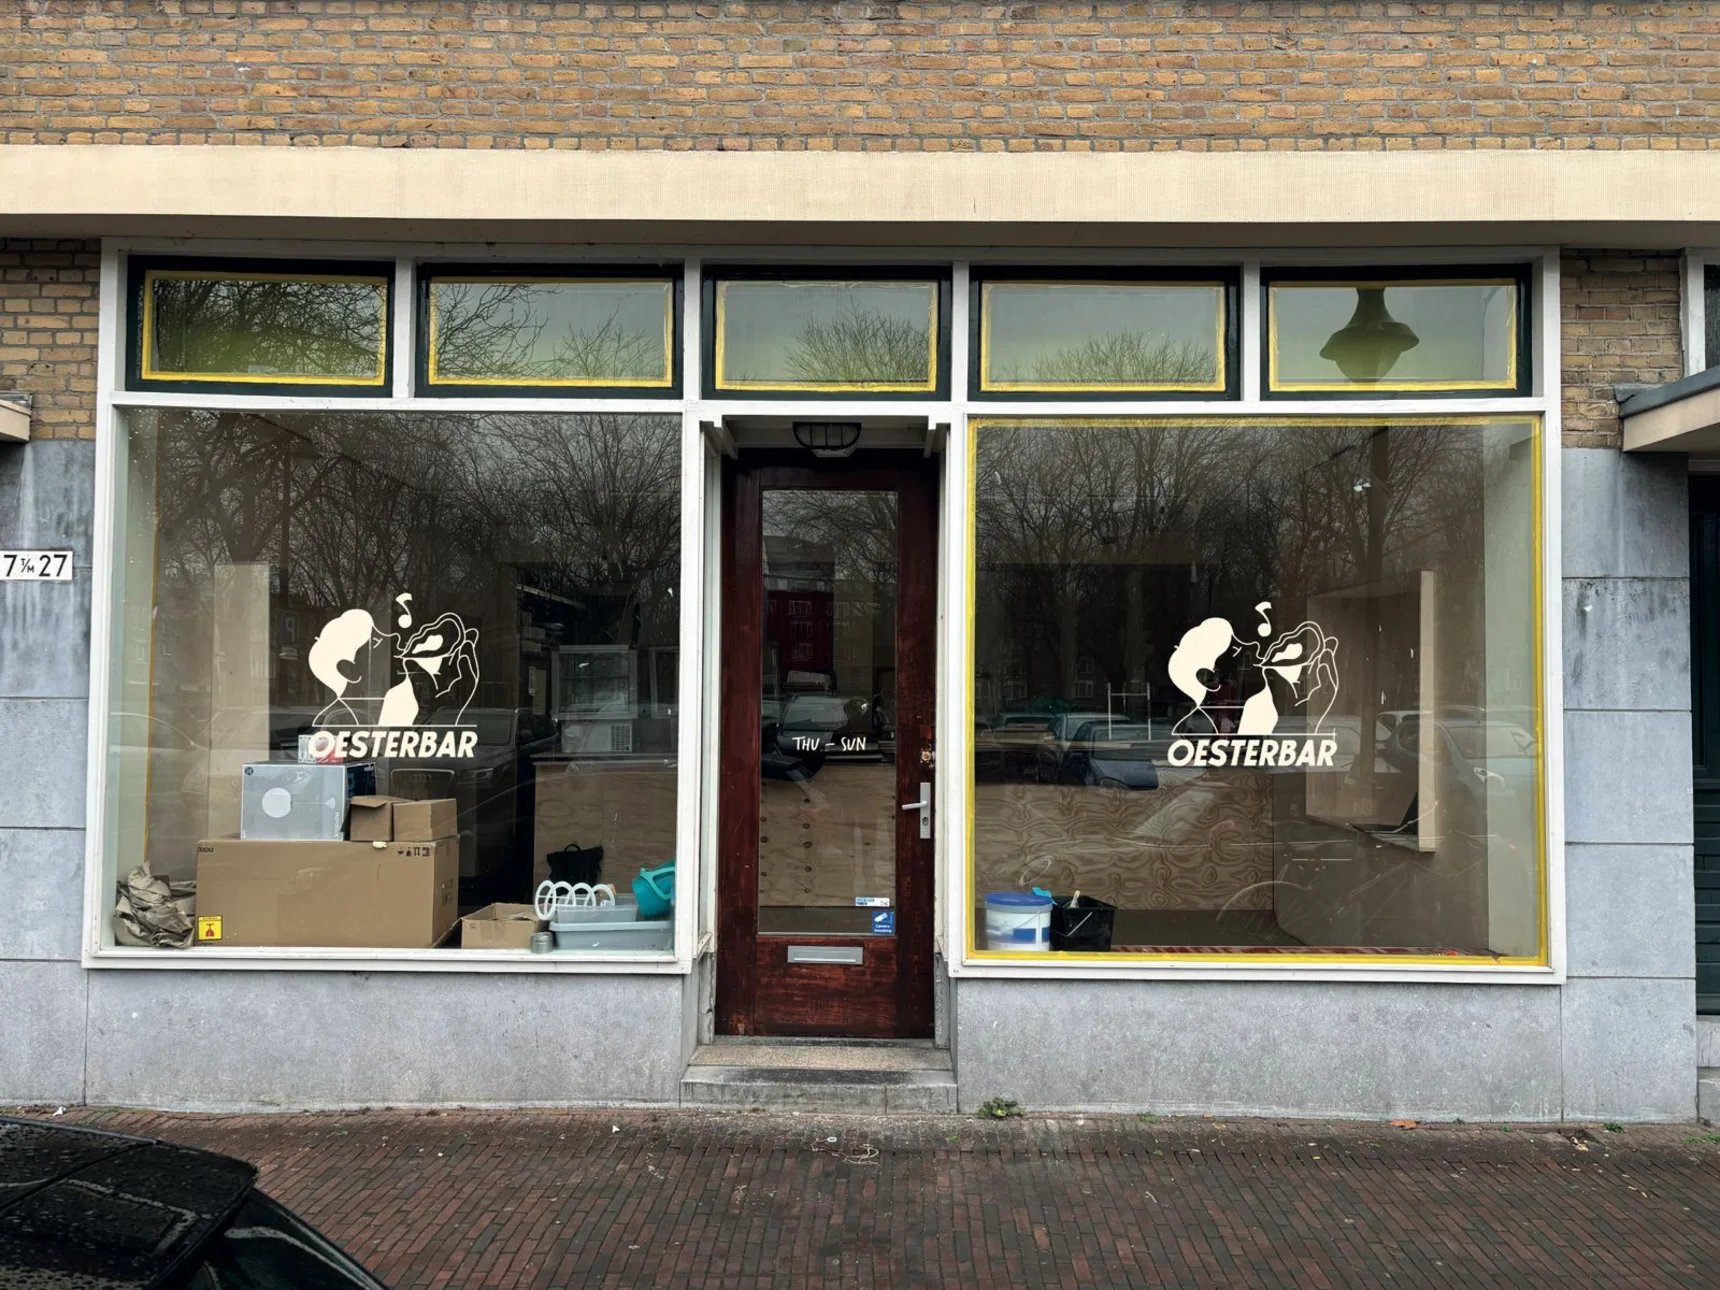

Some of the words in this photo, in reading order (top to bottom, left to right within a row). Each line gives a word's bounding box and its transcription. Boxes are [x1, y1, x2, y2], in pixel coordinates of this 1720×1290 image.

[3, 554, 18, 577] 7
[38, 554, 68, 577] 27
[308, 730, 479, 759] OESTERBAR
[791, 735, 821, 752] THU
[840, 736, 867, 752] SUN
[1167, 739, 1338, 767] OESTERBAR
